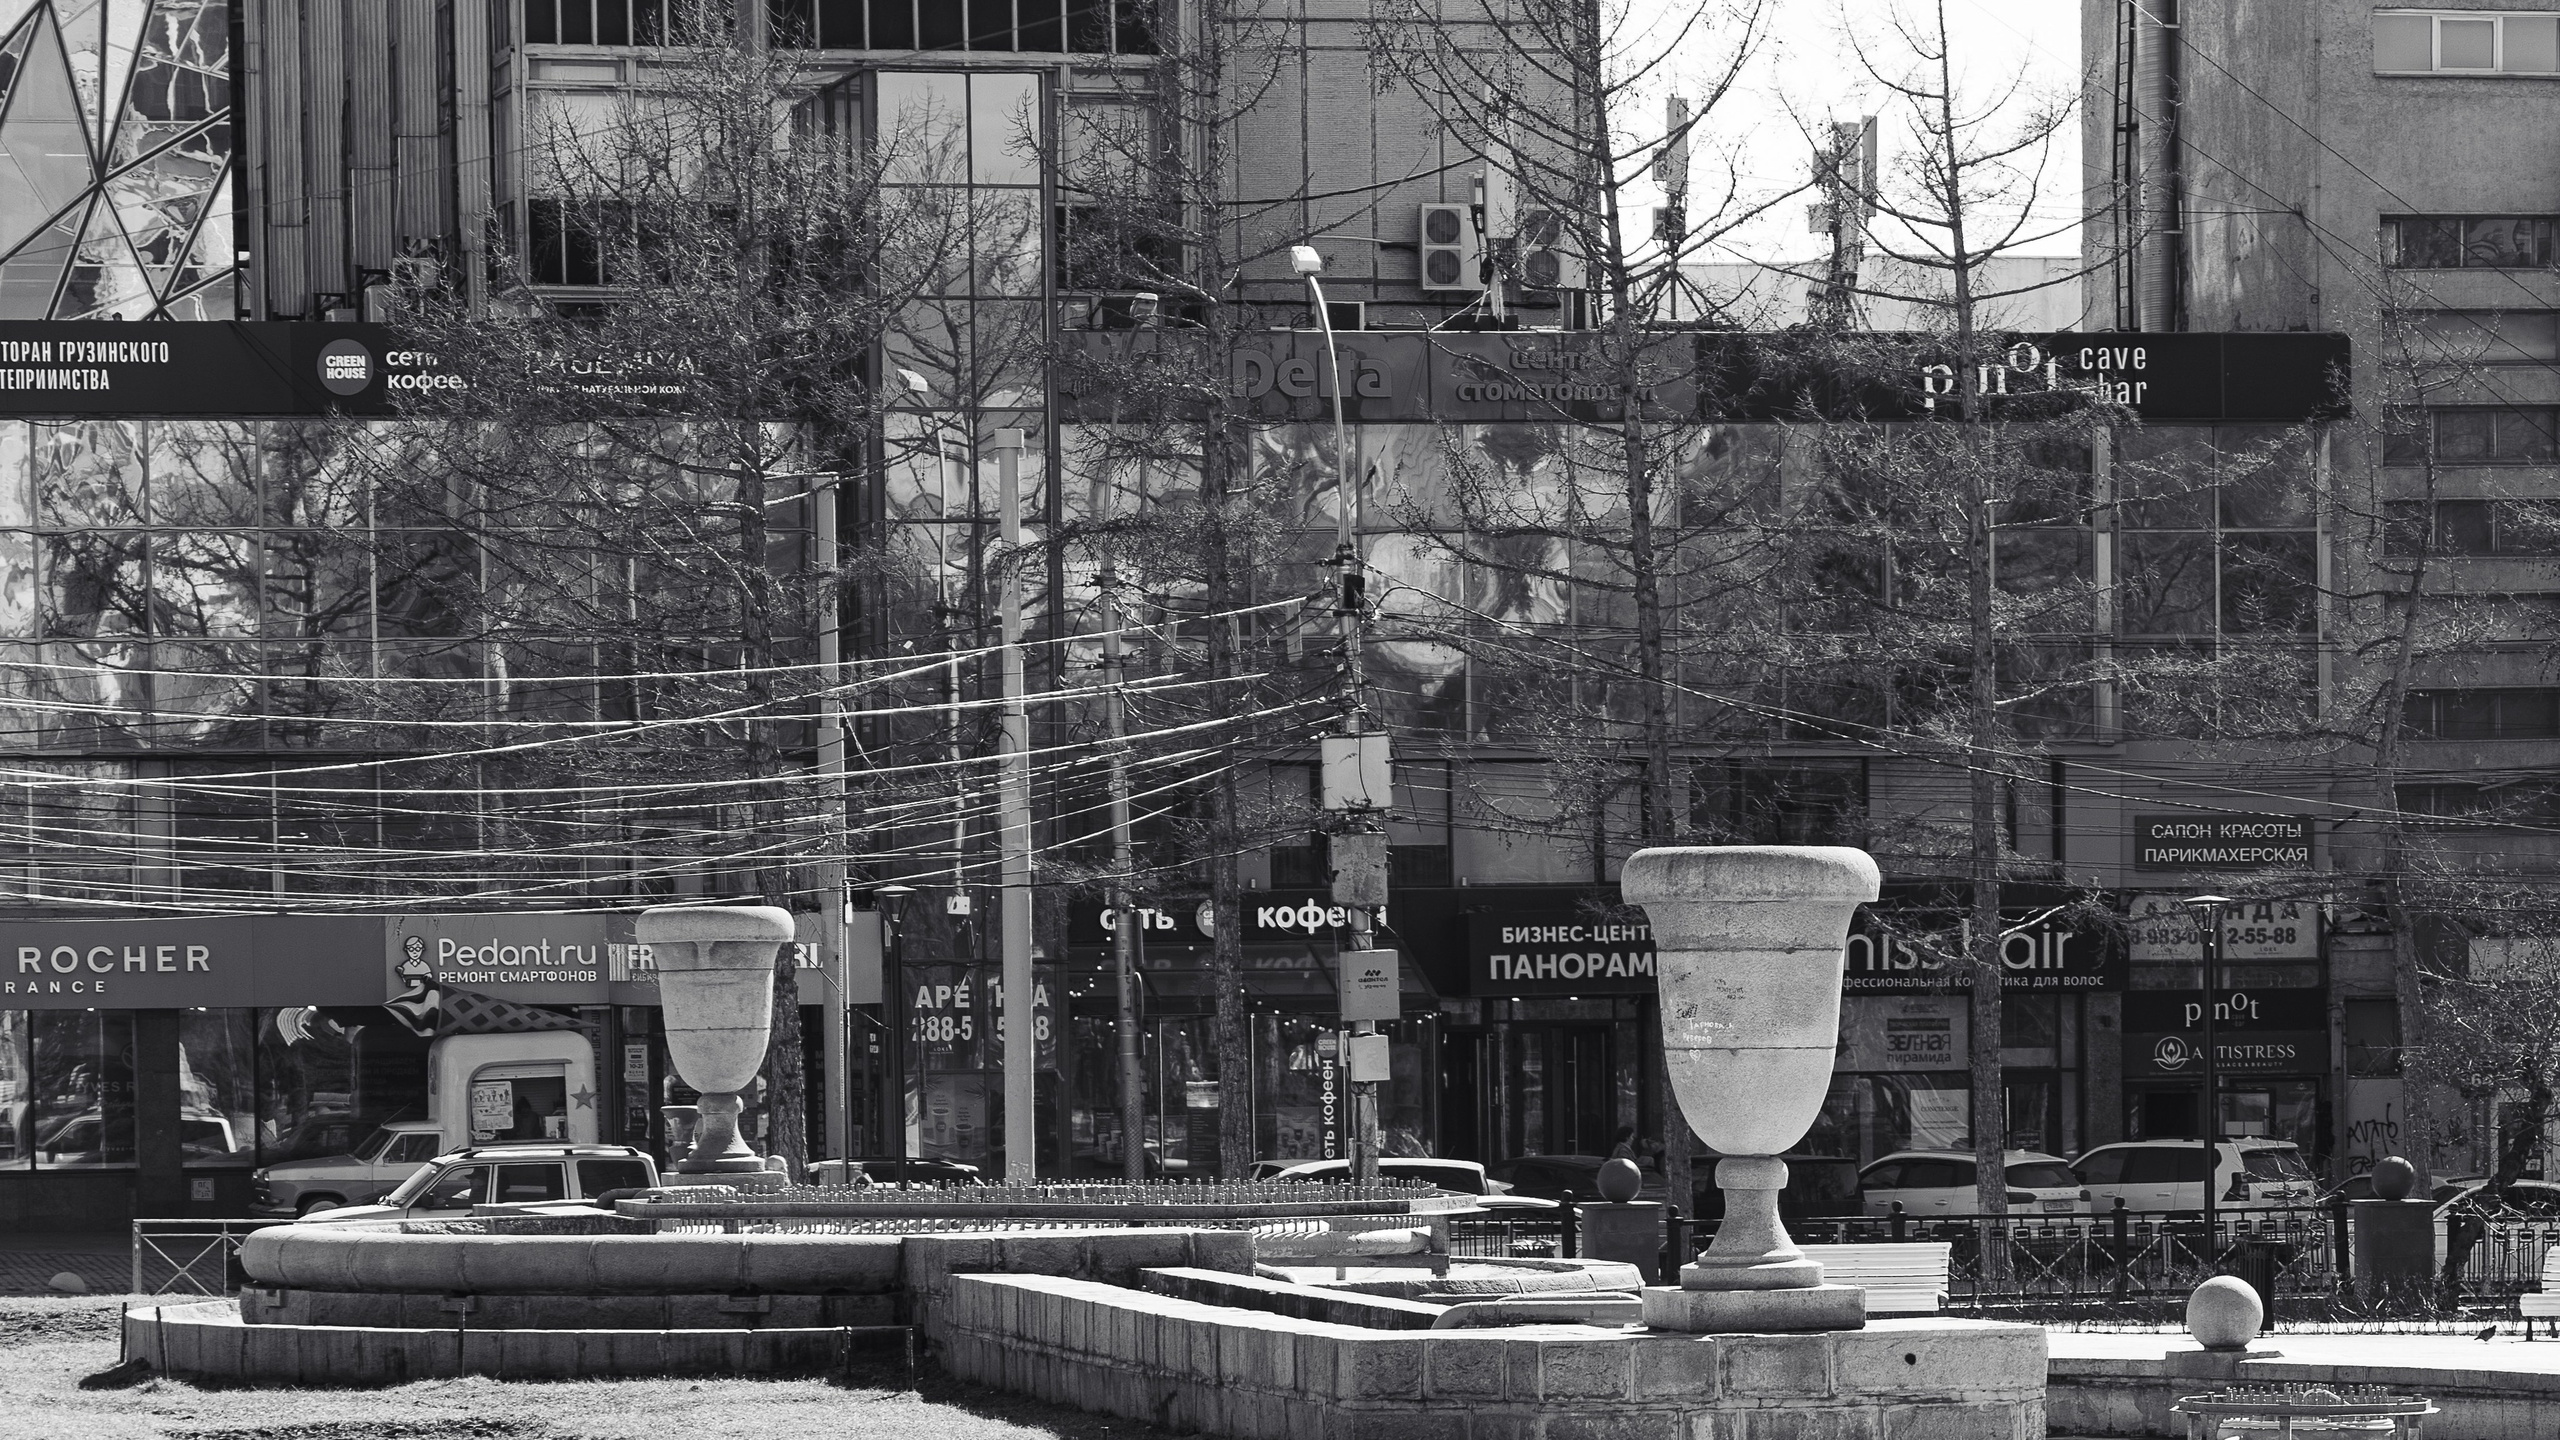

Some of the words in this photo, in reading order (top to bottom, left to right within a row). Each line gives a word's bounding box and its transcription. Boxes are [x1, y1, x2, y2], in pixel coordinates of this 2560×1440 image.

[1, 341, 51, 362] ТОРАН
[60, 342, 168, 363] ГРУЗИНСКОГО
[326, 356, 365, 367] GREEN
[2081, 348, 2145, 369] cave
[0, 369, 109, 390] ТЕПРИИМСТВА
[327, 368, 366, 379] HOUSE
[385, 371, 478, 396] кофее
[1922, 341, 2062, 408] pnot
[2097, 373, 2147, 404] bar
[2152, 824, 2211, 838] САЛОН
[2217, 820, 2304, 839] КРАСОТЫ
[2145, 848, 2308, 862] ПАРИКМАХЕРСКАЯ
[1099, 907, 1175, 931] сть
[1257, 898, 1387, 935] кофе
[1500, 923, 1655, 948] БИЗНЕС-ЦЕНТ
[19, 946, 209, 973] ROCHER
[439, 938, 596, 966] Pedant.ru
[1489, 950, 1658, 980] ПАНОРАМ
[5, 981, 104, 993] RANCE
[440, 972, 496, 982] РЕМОНТ
[500, 971, 596, 982] СМАРТФОНОВ
[1843, 973, 1950, 990] фессиональная
[1955, 973, 2028, 989] котика
[2034, 973, 2058, 988] для
[2062, 972, 2106, 987] волос
[2184, 992, 2260, 1027] pnot
[1887, 1053, 1951, 1065] пирамида
[2192, 1044, 2297, 1061] ATISTRESS
[1320, 1060, 1337, 1125] кофеен
[1324, 1130, 1335, 1160] еть
